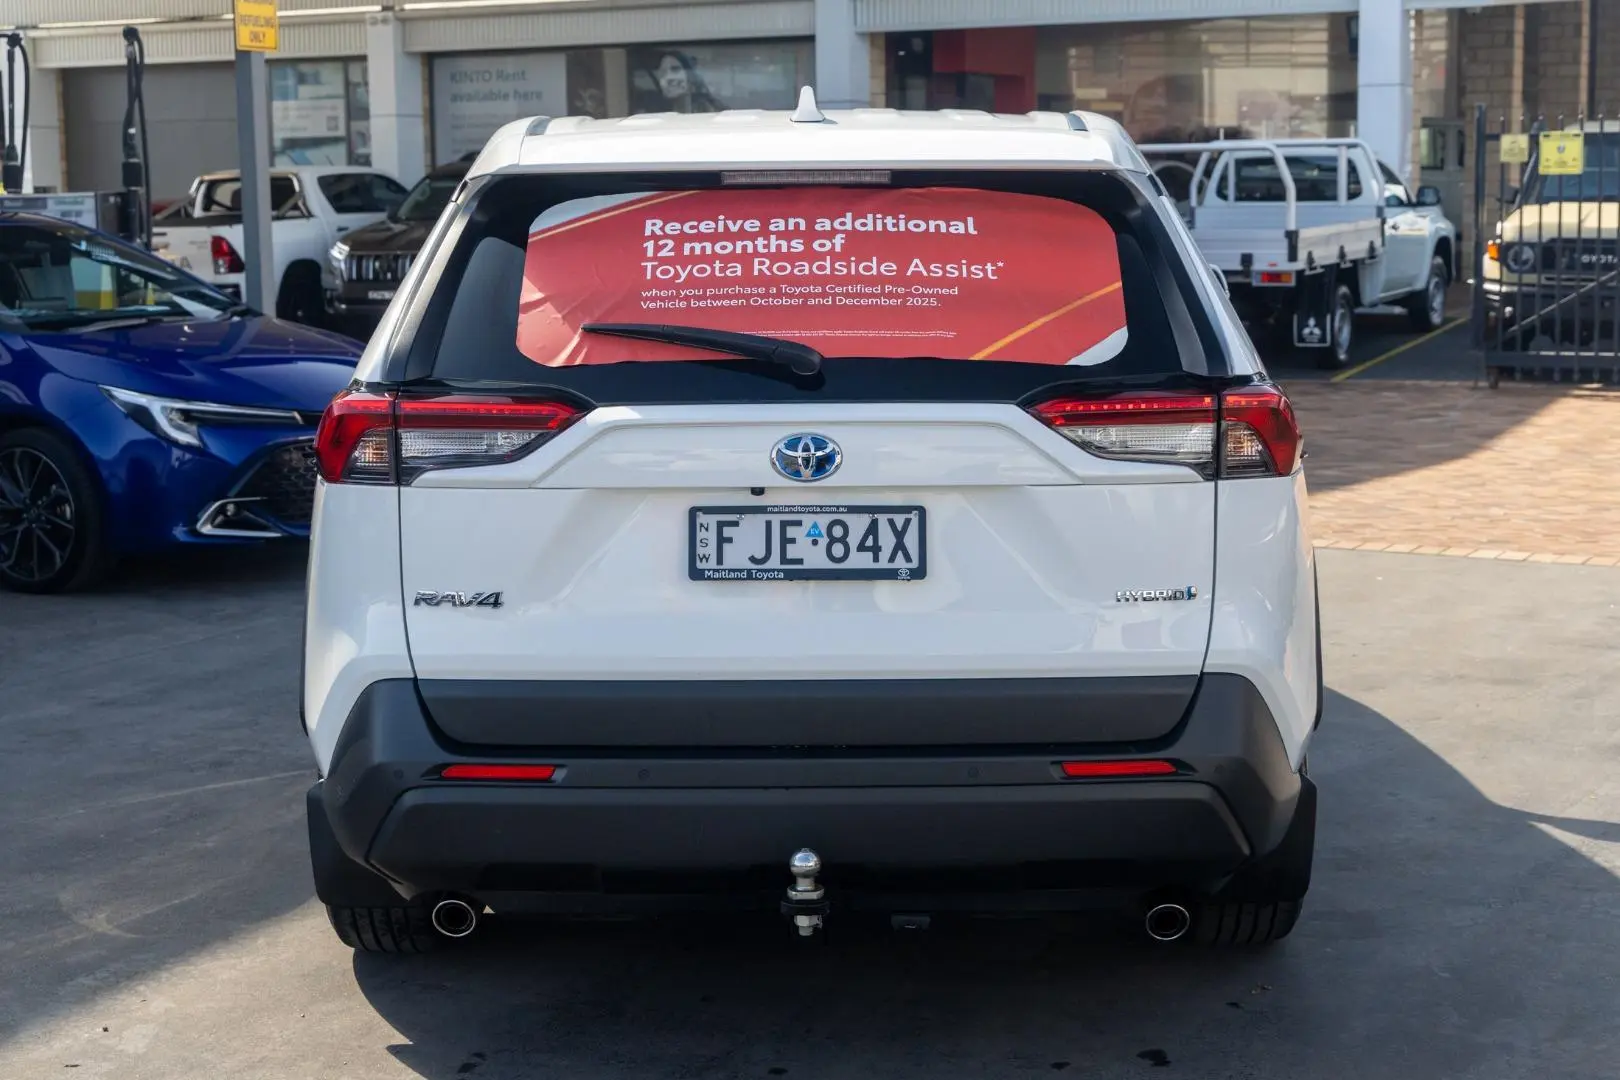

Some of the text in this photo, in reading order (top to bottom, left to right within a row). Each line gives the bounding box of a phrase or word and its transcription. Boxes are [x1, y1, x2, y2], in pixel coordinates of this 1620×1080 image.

[450, 69, 527, 83] KINTO Rent
[450, 88, 543, 103] available here
[644, 213, 978, 236] Receive an additional
[643, 234, 846, 257] 12 months of
[641, 259, 742, 283] Toyota
[753, 256, 897, 276] Roadside
[641, 288, 676, 297] when
[679, 287, 703, 297] you
[706, 285, 766, 296] purchase
[780, 284, 822, 295] Toyota
[826, 284, 881, 293] Certified
[885, 285, 958, 295] Pre-Owned
[641, 296, 941, 309] Vehicle between October and December 2025.
[767, 505, 848, 513] maitlandtoyota.com.au
[704, 569, 784, 581] Maitland Toyota
[413, 590, 504, 609] RAV4
[1116, 589, 1185, 602] HYBRID
